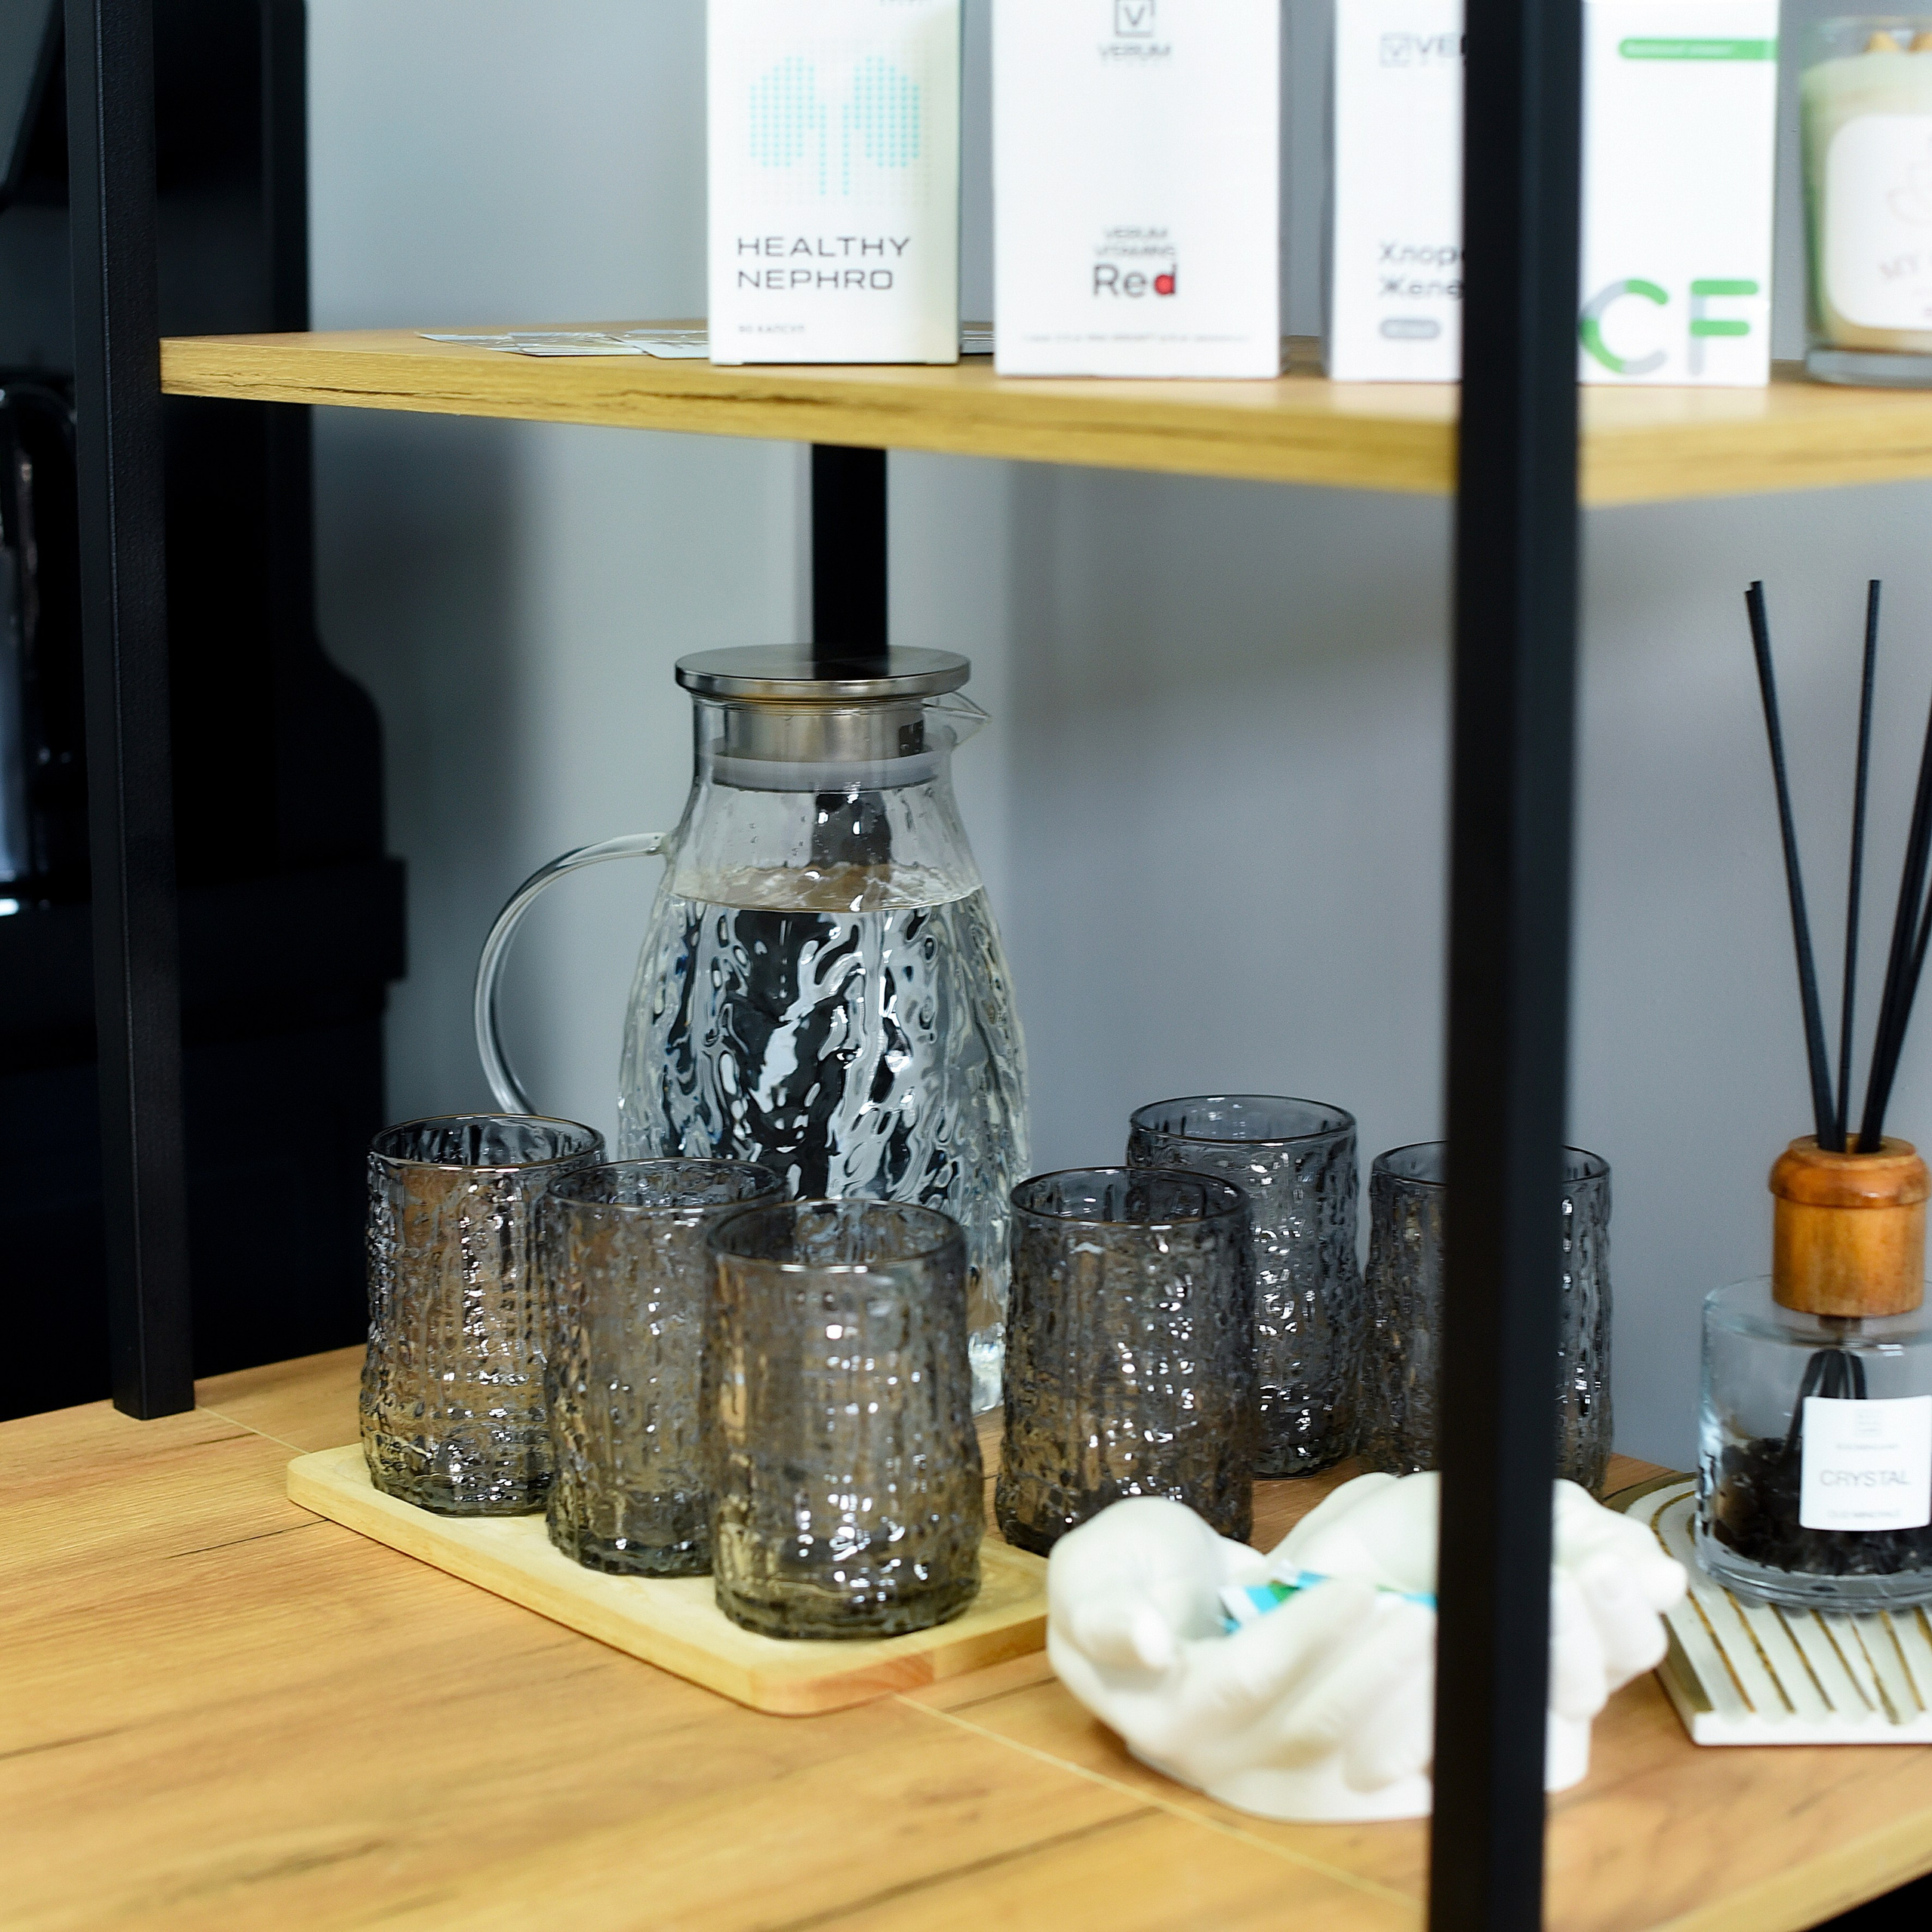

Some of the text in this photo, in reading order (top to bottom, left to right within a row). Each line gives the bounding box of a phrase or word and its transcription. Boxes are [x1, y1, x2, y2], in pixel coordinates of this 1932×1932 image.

[1414, 32, 1466, 58] VE
[737, 236, 911, 257] HEALTHY
[1379, 240, 1465, 269] Хлор
[737, 268, 894, 291] NEPHRO
[1093, 263, 1177, 299] Red
[1579, 278, 1761, 377] CF
[1819, 1469, 1911, 1487] CRYSTAL
